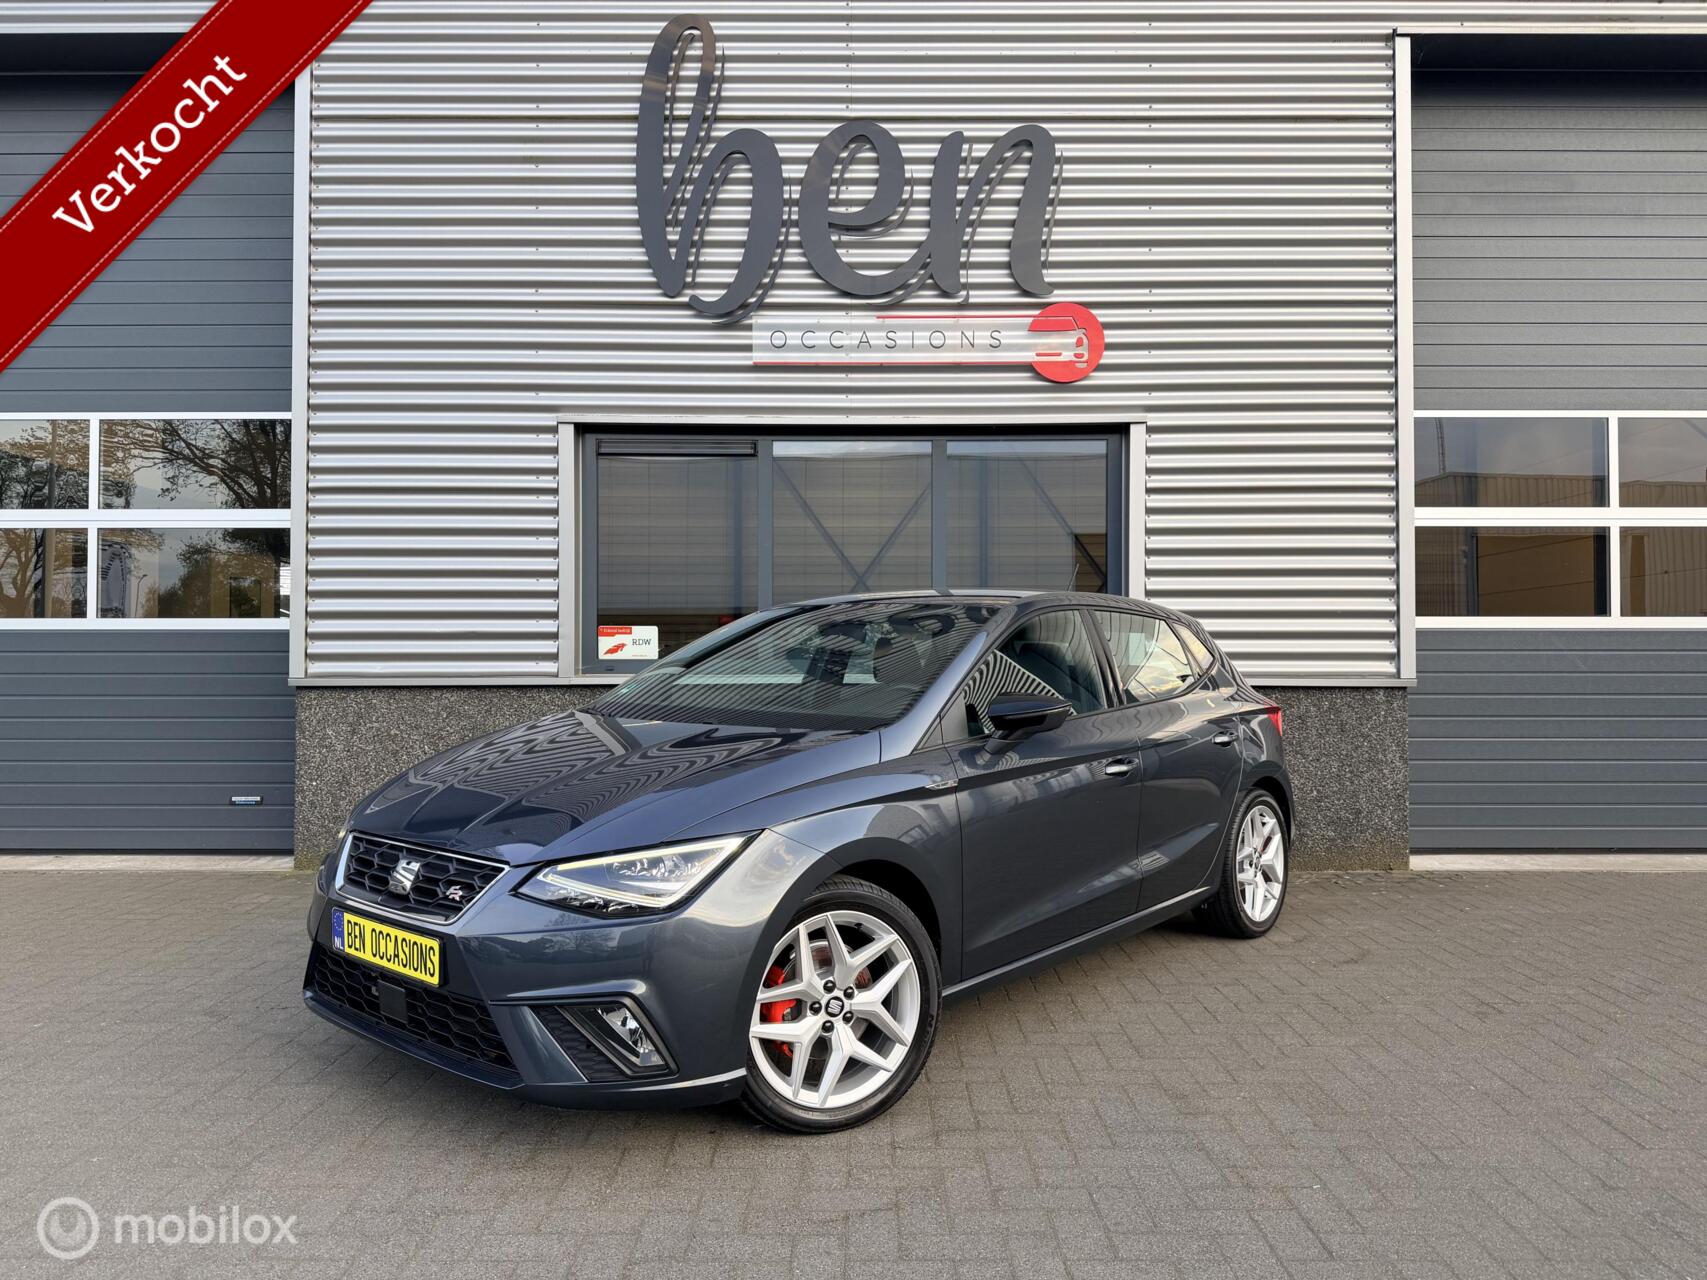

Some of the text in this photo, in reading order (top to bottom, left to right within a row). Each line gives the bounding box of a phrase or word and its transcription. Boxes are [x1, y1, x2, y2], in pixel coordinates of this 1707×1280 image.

[635, 14, 1056, 314] ben
[769, 329, 1003, 349] OCCASIONS
[631, 638, 652, 646] RDW
[334, 935, 344, 950] NL
[347, 919, 436, 978] BEN OCCASIONS
